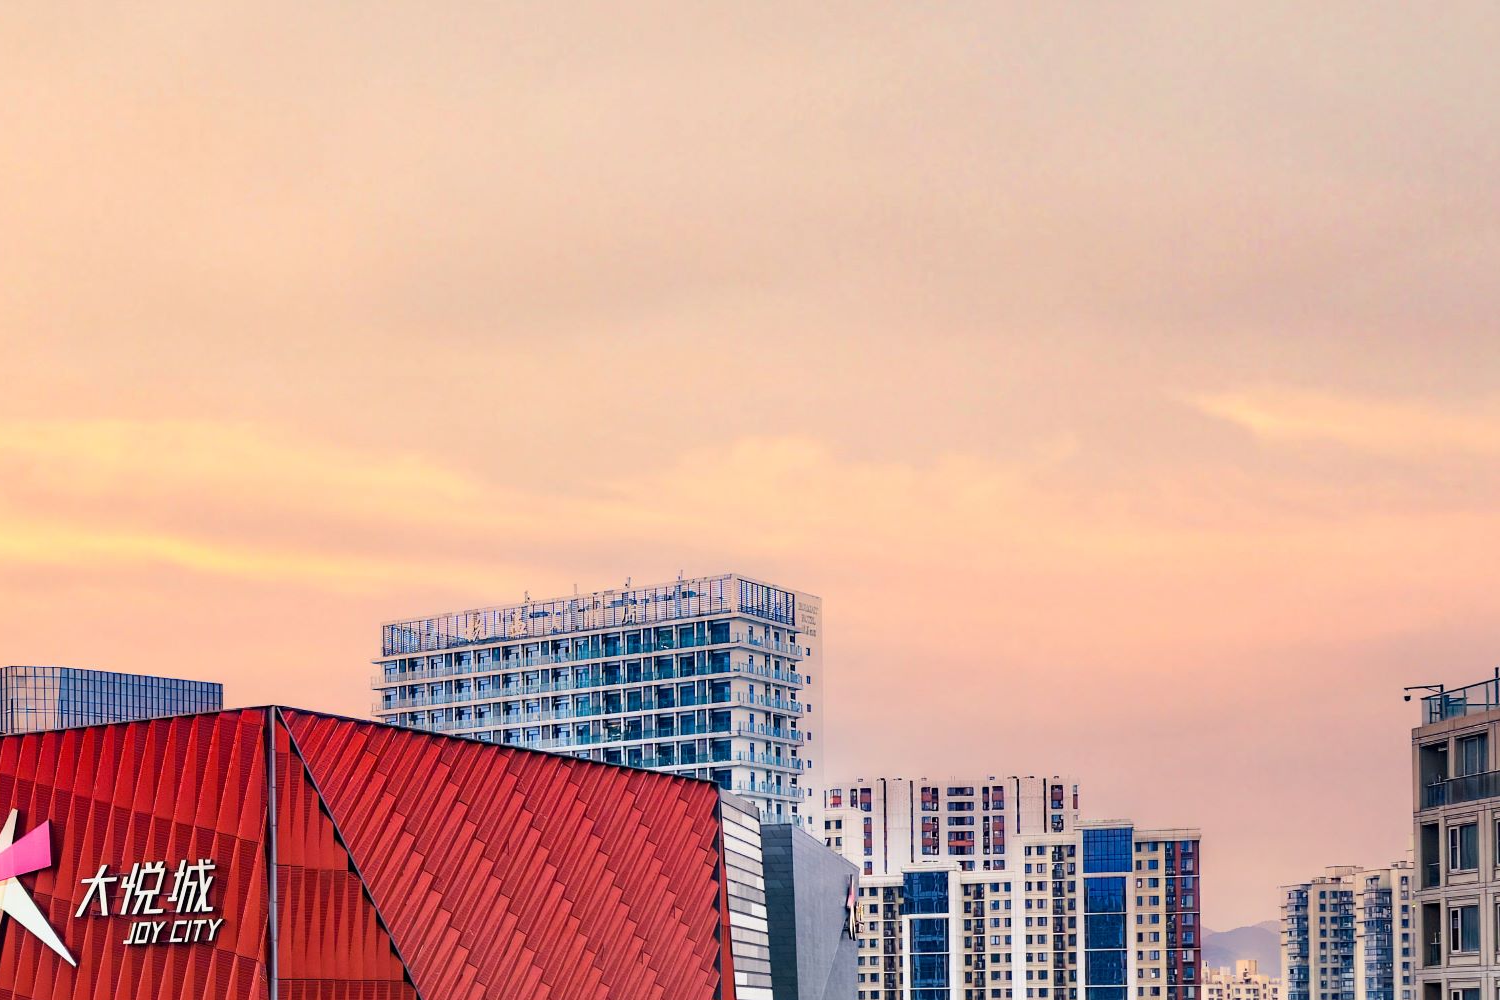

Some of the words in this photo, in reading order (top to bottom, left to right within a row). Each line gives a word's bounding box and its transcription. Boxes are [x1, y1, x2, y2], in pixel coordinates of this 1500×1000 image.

[75, 859, 216, 918] 大悦城
[123, 921, 166, 945] JOY
[169, 918, 224, 943] CITY
